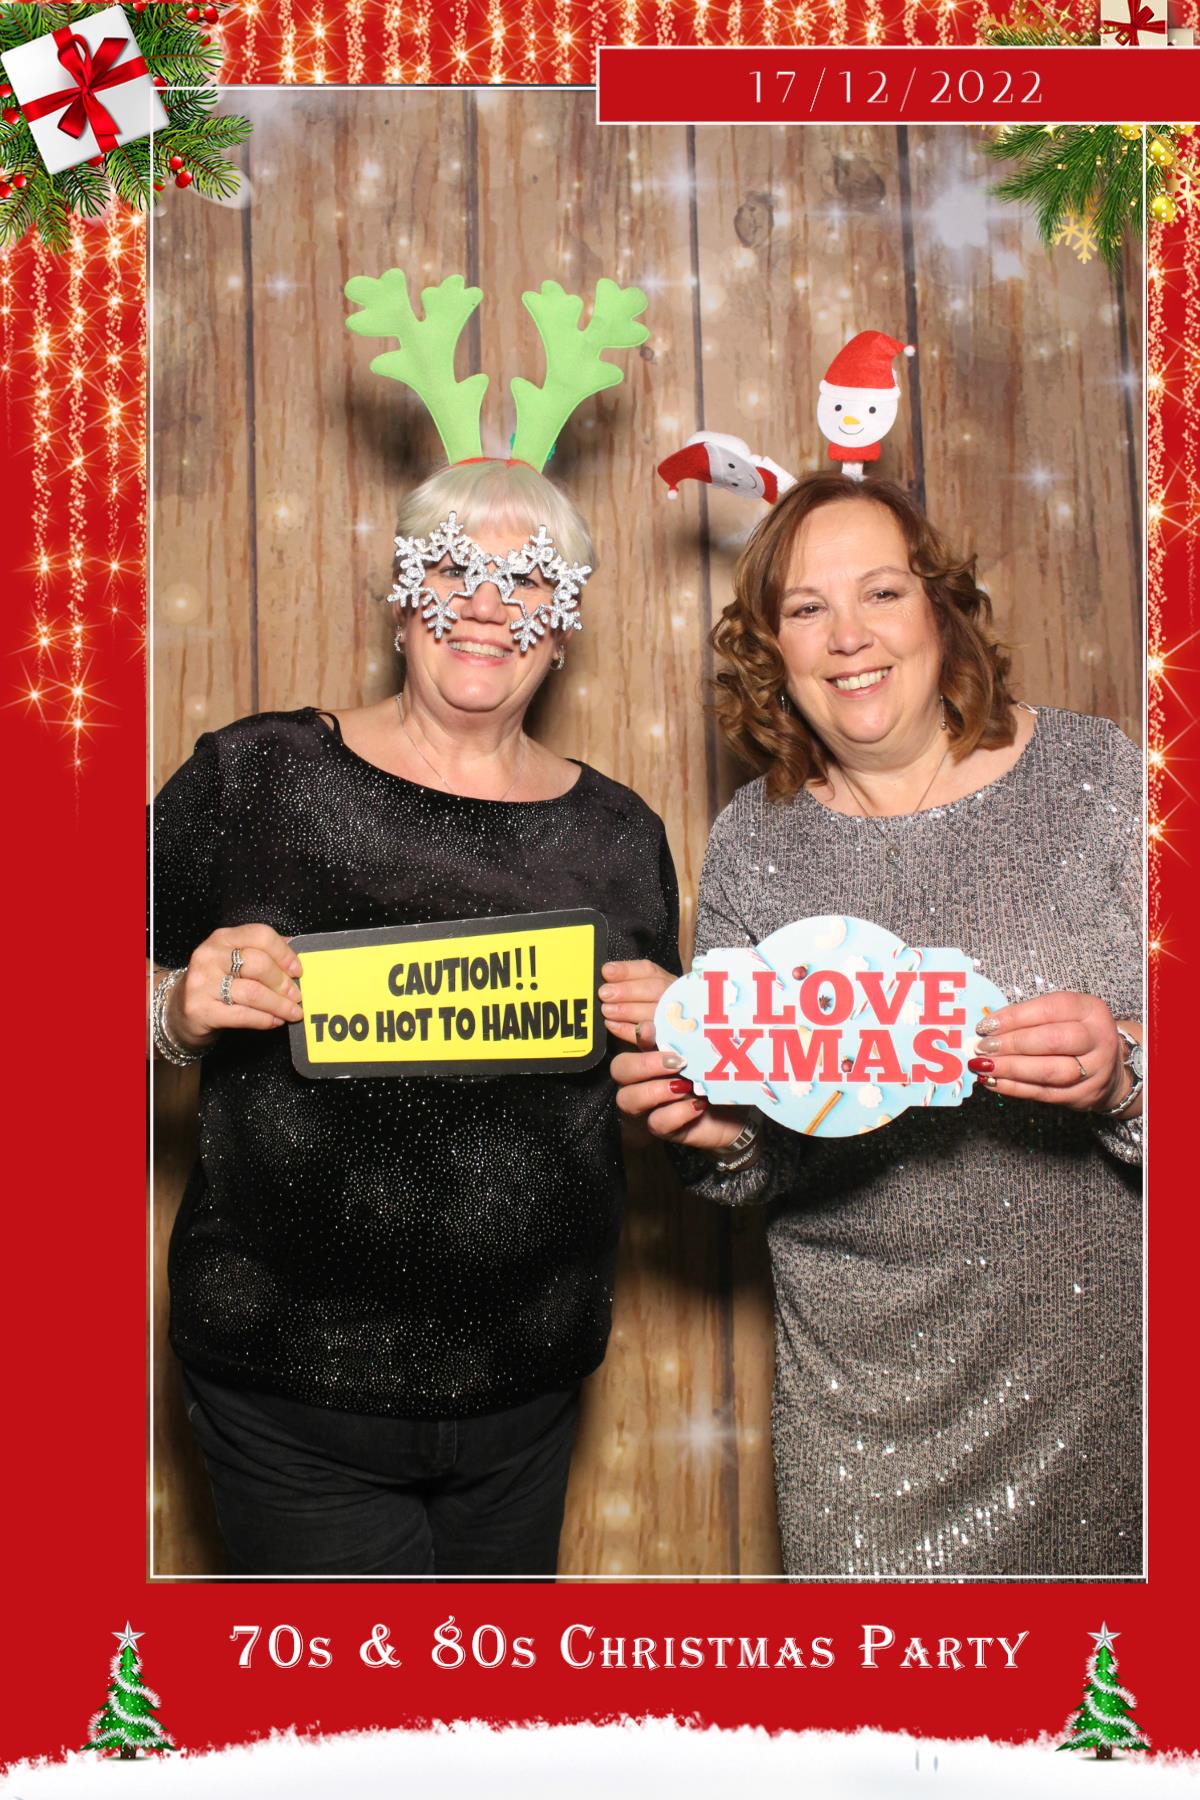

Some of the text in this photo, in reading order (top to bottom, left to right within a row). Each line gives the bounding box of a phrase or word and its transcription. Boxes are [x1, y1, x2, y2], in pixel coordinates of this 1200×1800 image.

[387, 945, 538, 997] CAUTION!!
[703, 969, 967, 1027] I LOVE
[310, 998, 588, 1043] TOO HOT TO HANDLE
[703, 1028, 964, 1085] XMAS
